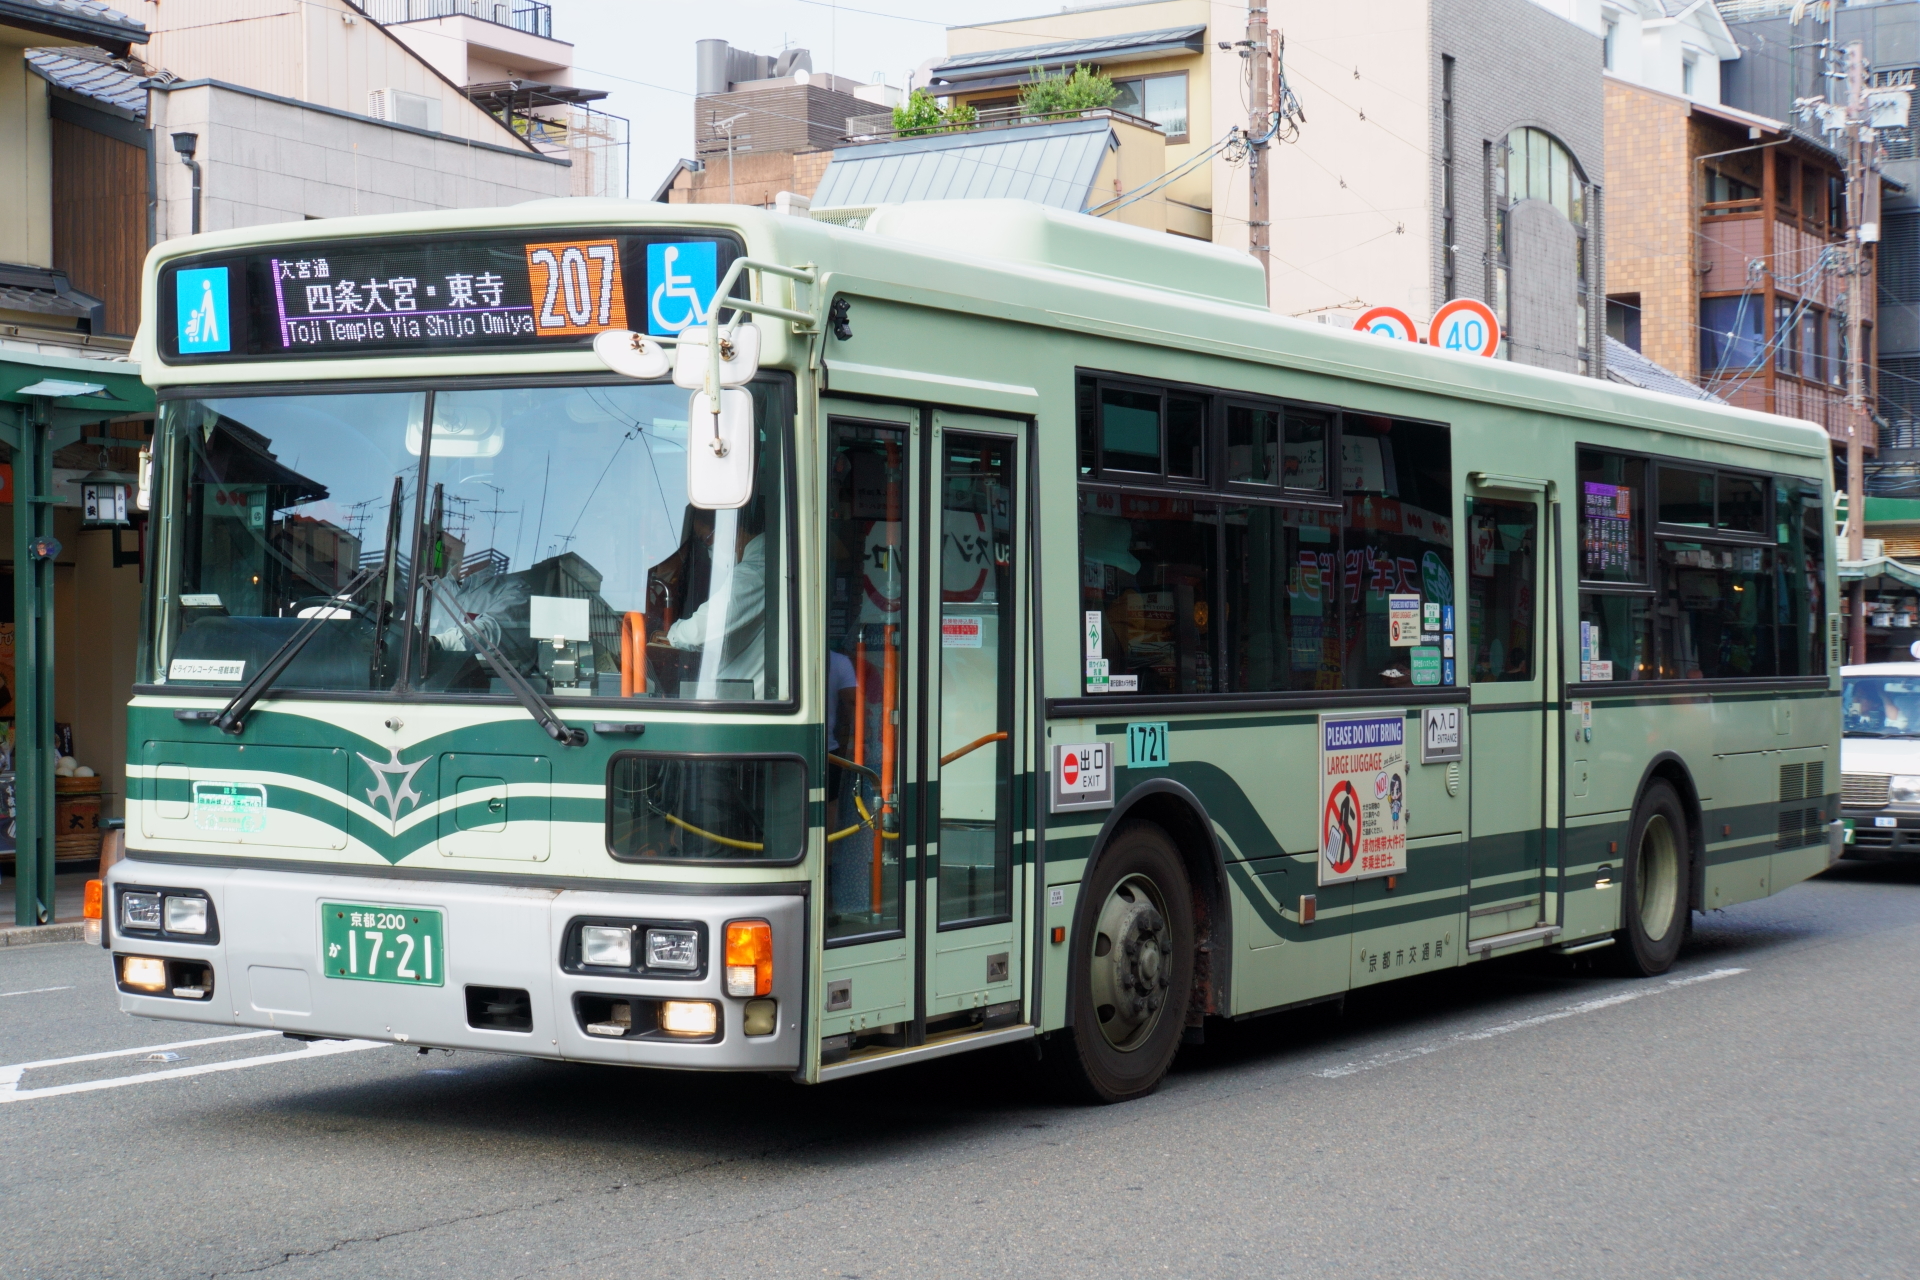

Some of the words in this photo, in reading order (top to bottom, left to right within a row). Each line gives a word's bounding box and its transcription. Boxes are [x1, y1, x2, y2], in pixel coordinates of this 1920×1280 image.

[279, 259, 330, 279] 大宮通
[532, 246, 614, 329] 207
[287, 320, 322, 343] Toji
[327, 318, 384, 342] Temple
[390, 317, 420, 338] Via
[426, 314, 475, 338] Shijo
[482, 312, 534, 335] Omiya
[1446, 320, 1482, 351] 40
[1440, 712, 1455, 730] 入口
[1130, 725, 1165, 763] 1721
[1327, 726, 1352, 746] PLEASE
[1352, 725, 1364, 745] DO
[1364, 724, 1380, 744] NOT
[1380, 722, 1402, 742] BRING
[1437, 733, 1457, 744] ENTRANCE
[1080, 749, 1103, 771] 出口
[1327, 754, 1349, 775] LARGE
[1350, 752, 1382, 773] LUGGAGE
[1083, 774, 1100, 788] EXIT
[1375, 777, 1387, 796] NO!
[328, 942, 342, 958] か
[349, 929, 432, 980] 17-21
[1368, 940, 1443, 973] 京都市交通局
